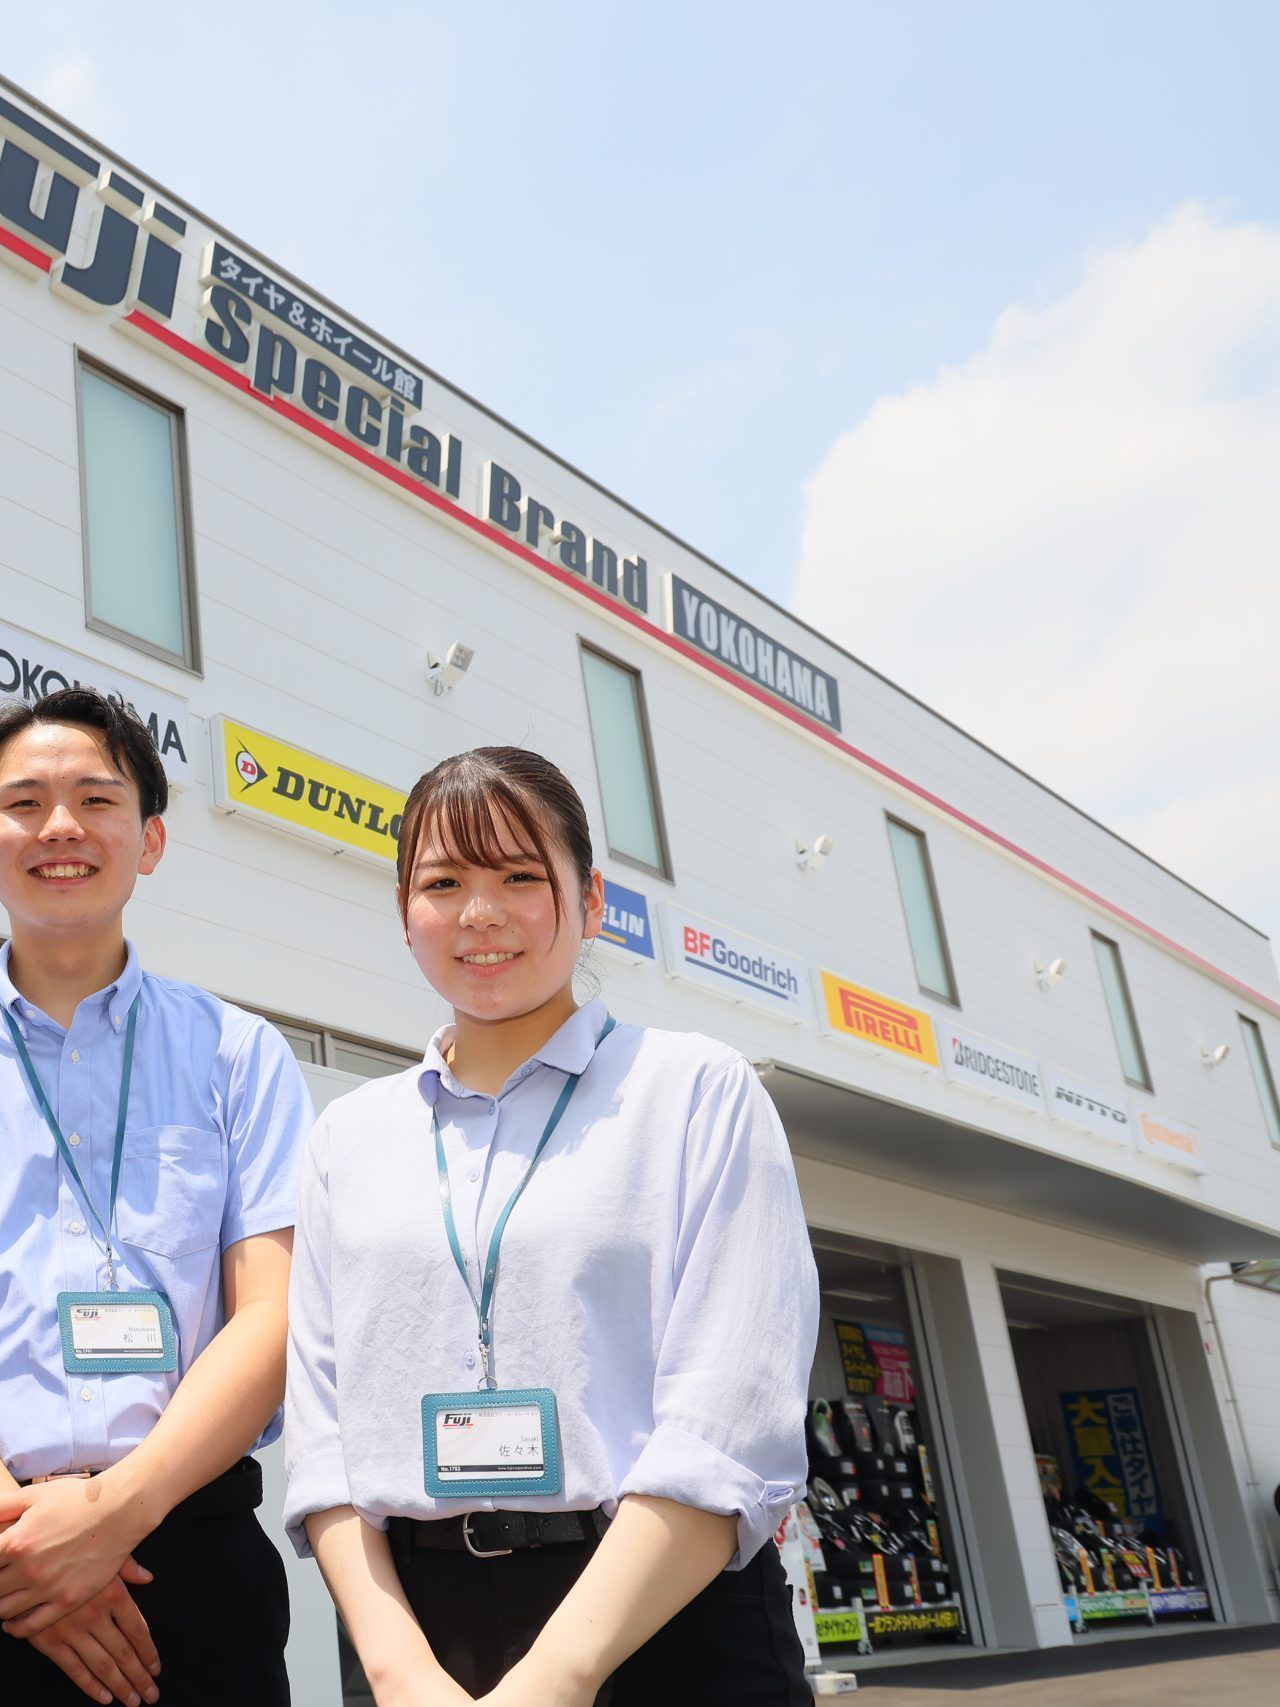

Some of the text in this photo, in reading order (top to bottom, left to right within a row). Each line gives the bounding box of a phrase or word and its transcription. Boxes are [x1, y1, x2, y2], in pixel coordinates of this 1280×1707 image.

[220, 256, 416, 401] タイヤ&ホイール館
[204, 285, 648, 615] Special Brand
[681, 588, 832, 721] YOKOHAMA
[684, 925, 798, 995] BFGoodrich
[837, 987, 923, 1053] PIRELLI
[952, 1038, 1040, 1097] BRIDGESTONE
[444, 1412, 472, 1426] Fuji
[499, 1444, 539, 1457] 佐々木
